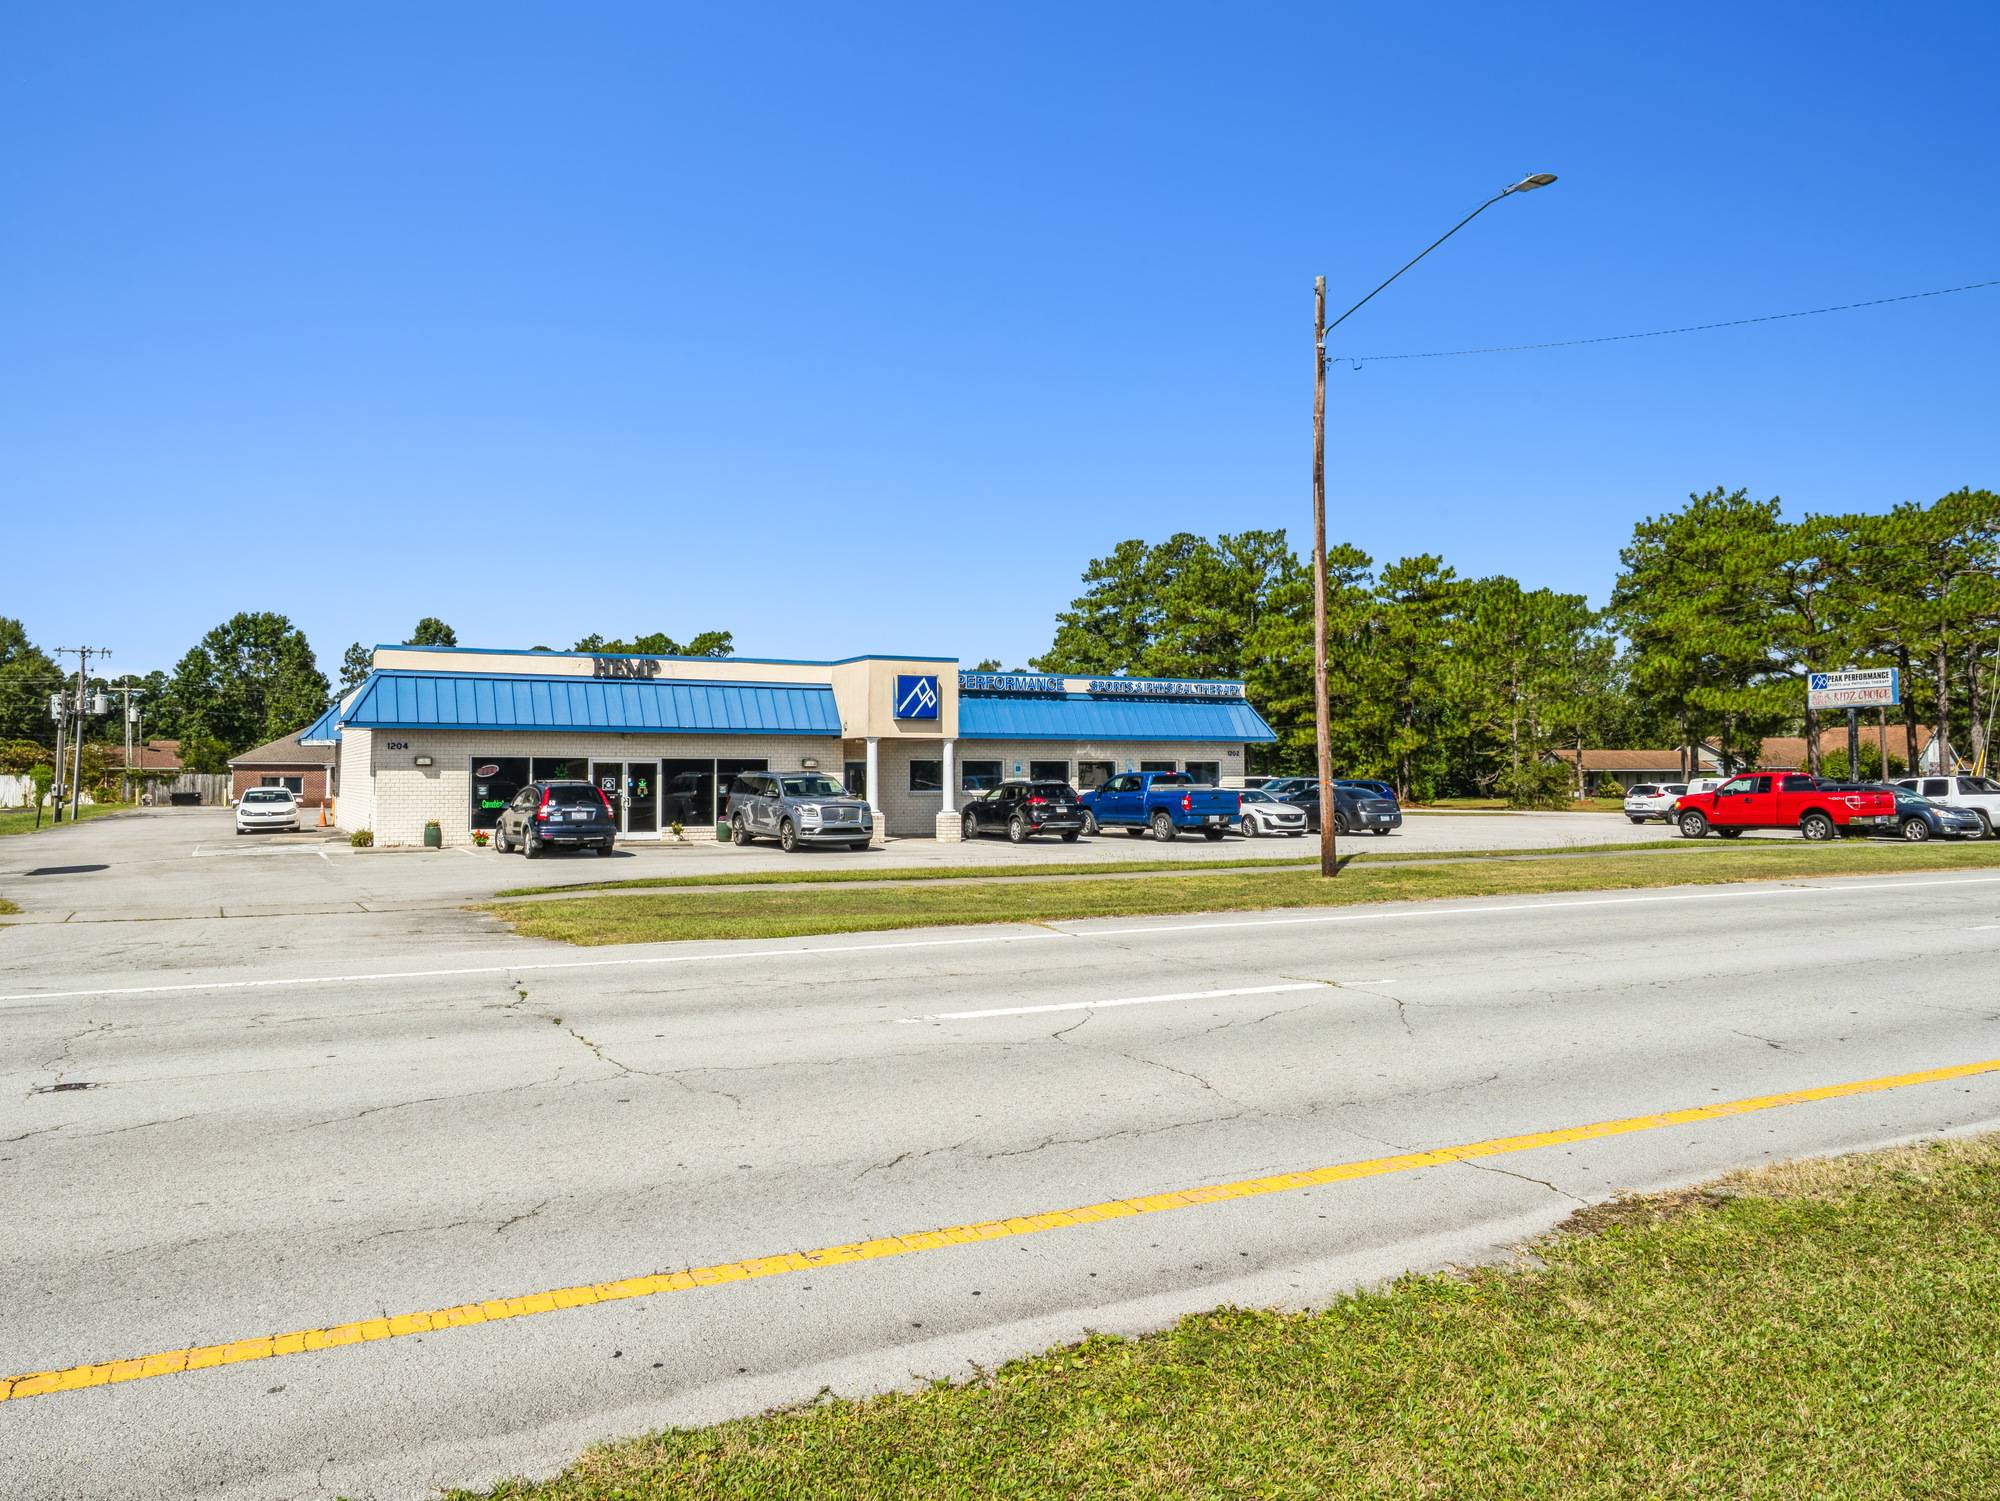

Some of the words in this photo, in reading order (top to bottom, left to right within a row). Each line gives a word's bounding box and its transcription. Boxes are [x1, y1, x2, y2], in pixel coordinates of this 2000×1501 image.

[593, 658, 662, 679] HEMP
[959, 675, 1065, 691] PERFORMANCE
[1828, 674, 1843, 683] PEAK
[1844, 671, 1889, 682] PERFORMANCE
[1089, 680, 1134, 693] SPORTS
[1135, 682, 1143, 694] &
[1144, 682, 1195, 695] PHYSICAL
[1195, 684, 1242, 696] THERAPY
[1858, 688, 1889, 700] CHOICE
[387, 742, 408, 750] 1204
